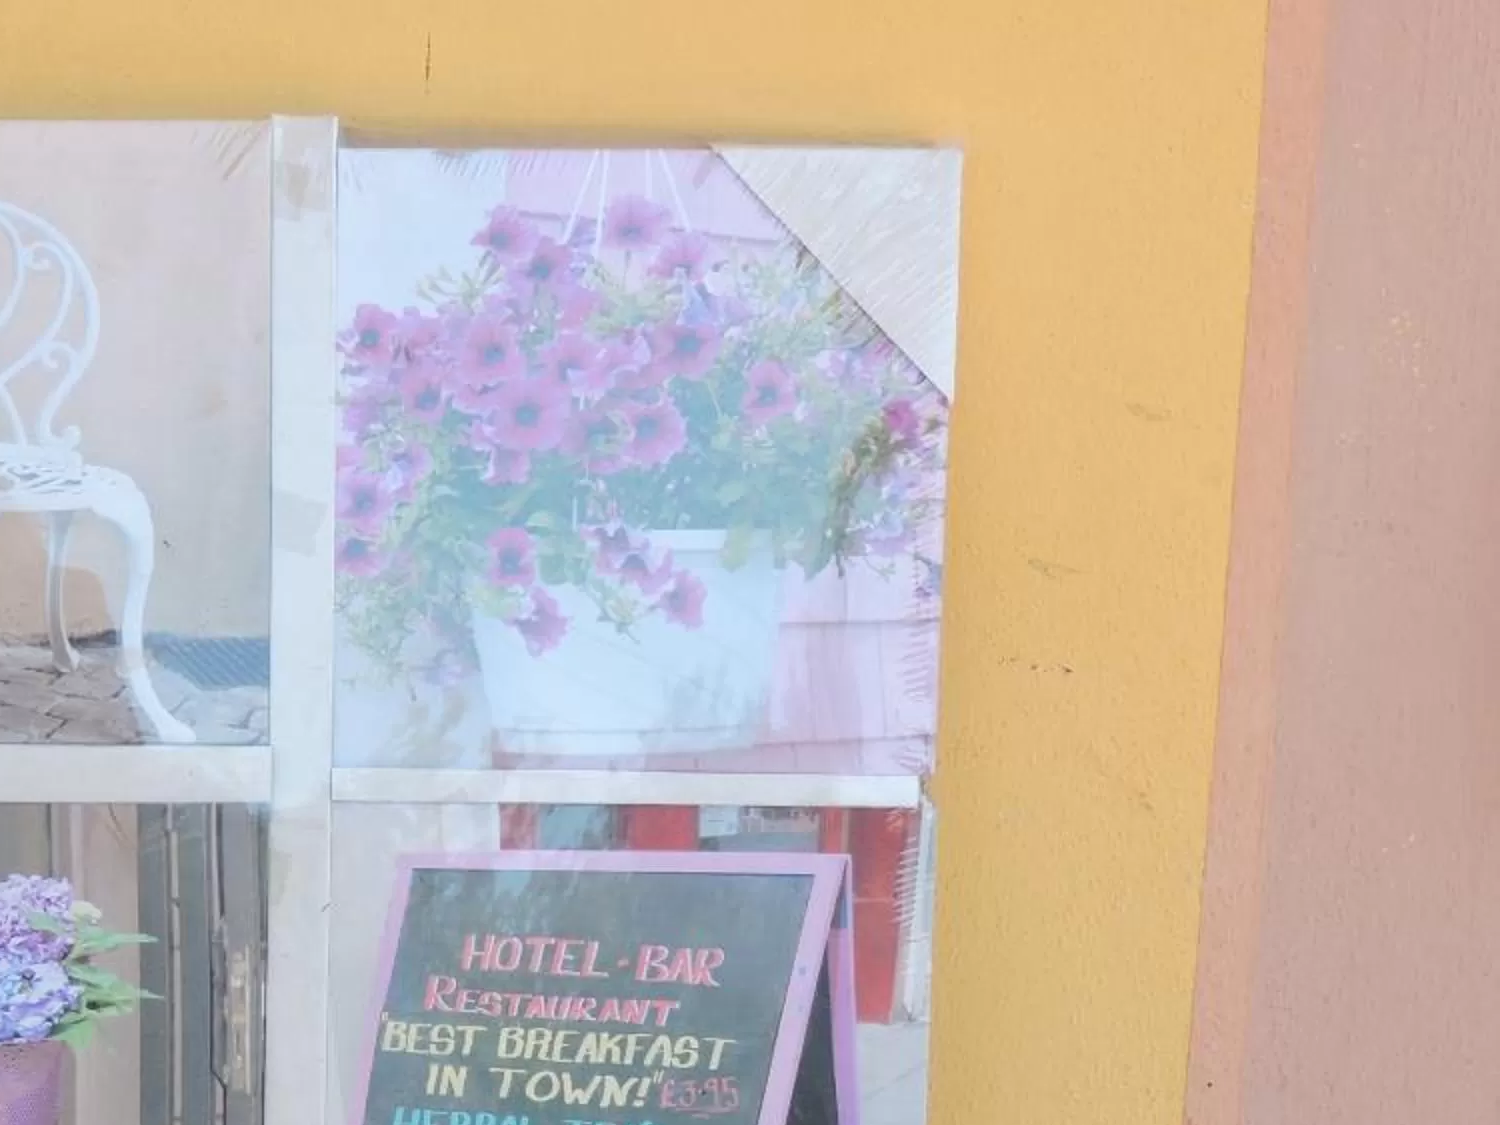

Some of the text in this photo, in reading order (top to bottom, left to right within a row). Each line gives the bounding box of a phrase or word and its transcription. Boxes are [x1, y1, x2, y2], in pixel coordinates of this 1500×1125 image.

[461, 933, 609, 978] HOTEL
[635, 943, 726, 988] BAR
[497, 1026, 738, 1070] BREAKFAST
[426, 1063, 468, 1098] IN
